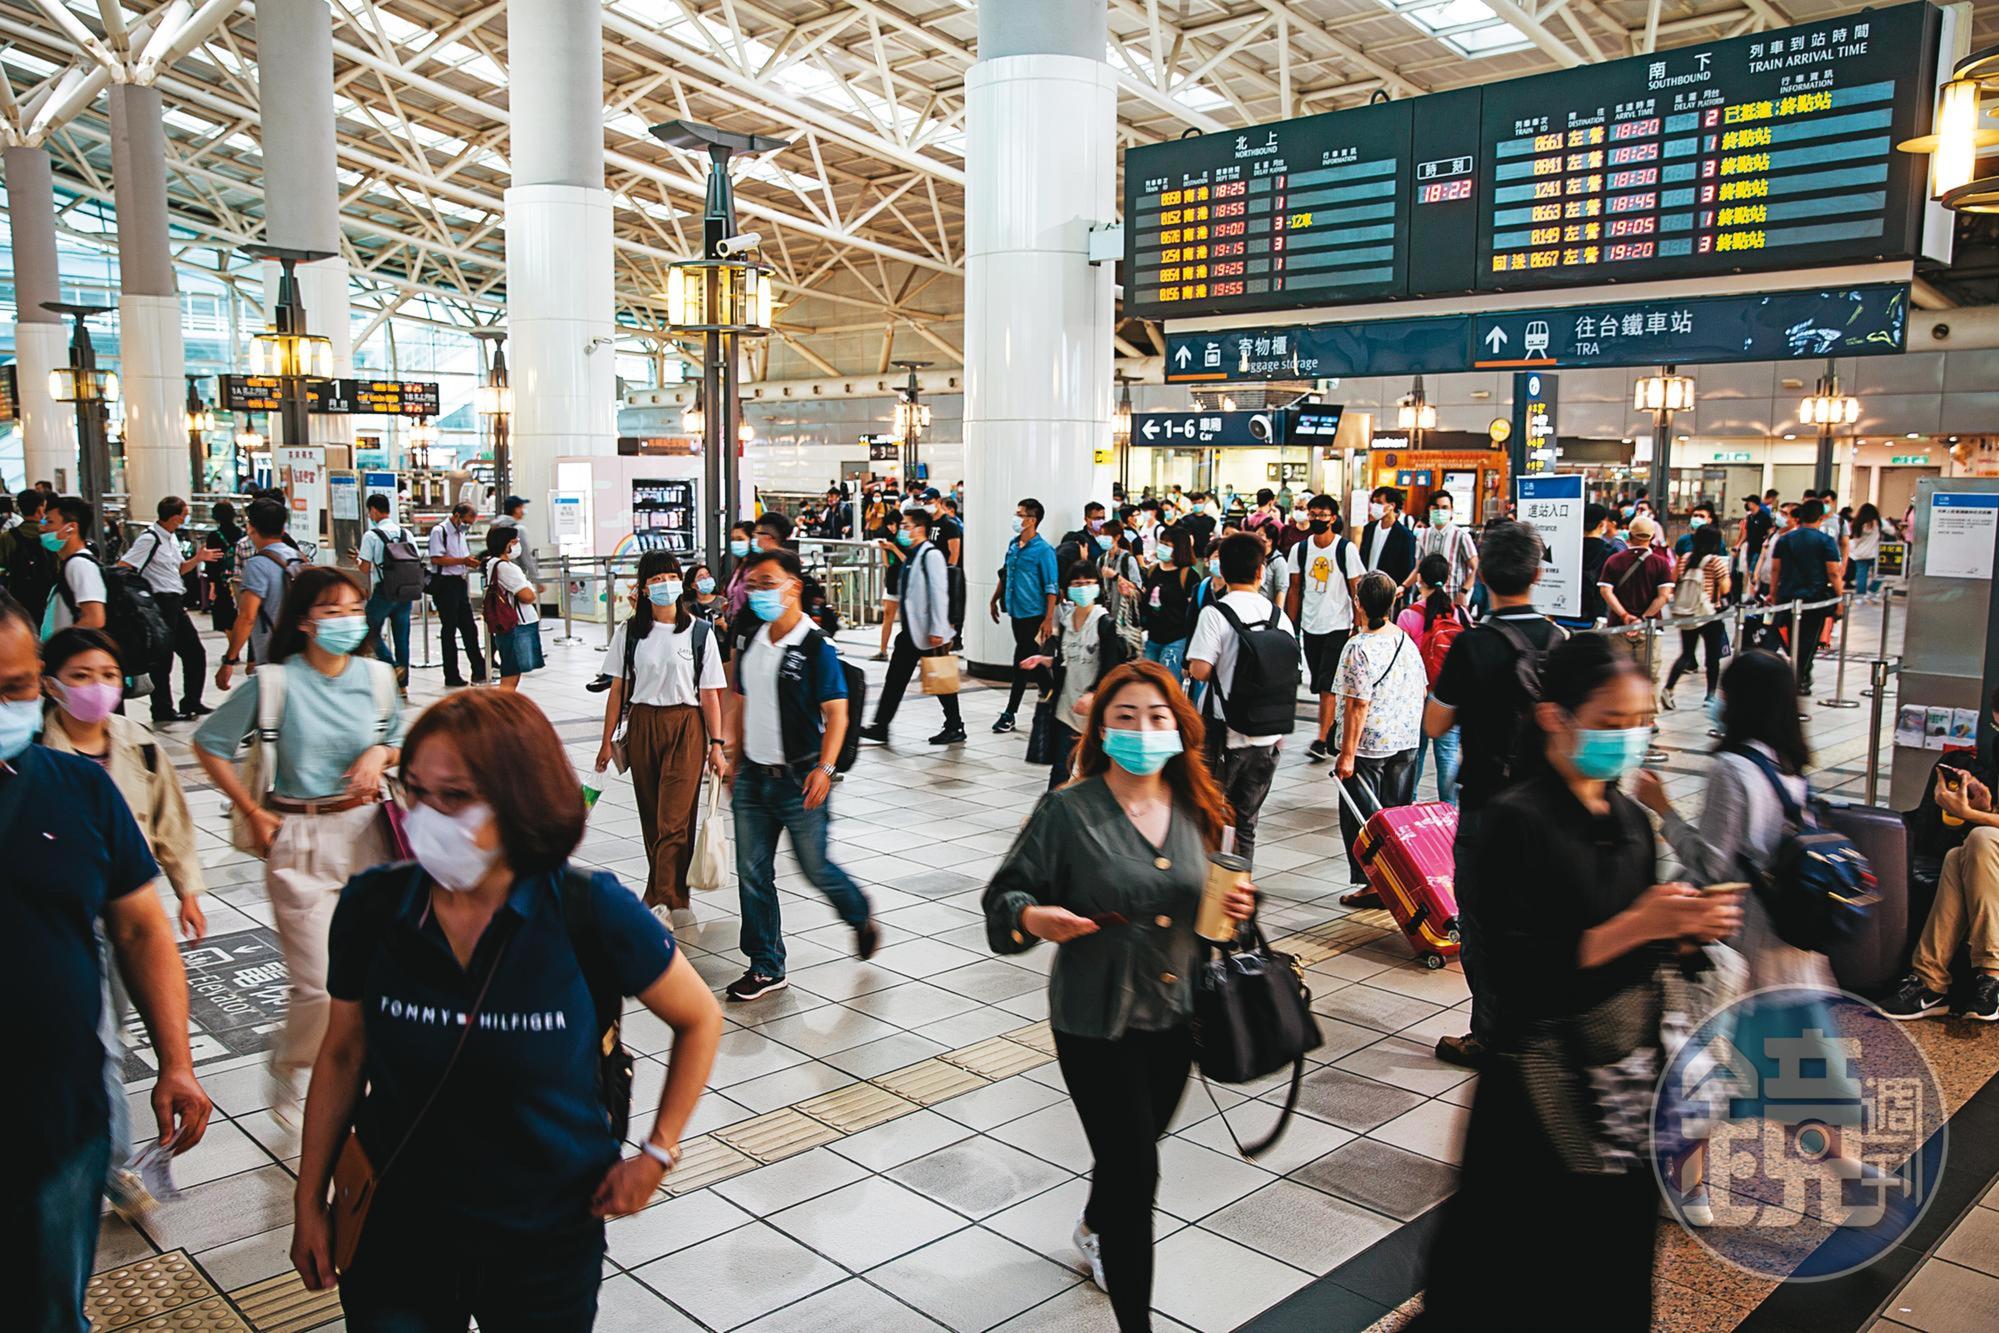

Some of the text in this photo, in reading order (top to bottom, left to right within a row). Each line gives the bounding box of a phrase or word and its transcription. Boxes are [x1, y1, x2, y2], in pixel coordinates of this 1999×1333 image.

[1749, 23, 1869, 59] 列車到站時間
[1649, 52, 1712, 81] 南下
[1749, 42, 1868, 74] TRAIN ARRIVAL TIME
[1648, 71, 1711, 91] SOUTHBOUND
[1780, 78, 1833, 94] INFORMATION
[1515, 127, 1533, 136] TRAIN
[1540, 124, 1548, 132] ID
[1568, 116, 1605, 128] DESTINATION
[1638, 107, 1654, 117] TIME
[1674, 100, 1695, 111] DELAY
[1698, 97, 1724, 108] PLATFORM
[1615, 117, 1660, 139] 18:20
[1704, 108, 1720, 127] 2
[1235, 131, 1277, 151] 北上
[1614, 143, 1659, 163] 18:25
[1710, 135, 1717, 150] 1
[1235, 145, 1278, 159] NORTHBOUND
[1322, 155, 1357, 166] INFORMATION
[1425, 160, 1464, 176] 時刻
[1214, 181, 1245, 198] 18:25
[1278, 176, 1285, 189] 1
[1534, 180, 1562, 199] 1241
[1613, 167, 1658, 187] 18:30
[1703, 160, 1717, 178] 3
[1424, 179, 1472, 203] 18:22
[1214, 202, 1245, 217] 18:55
[1277, 196, 1284, 210] 1
[1532, 203, 1561, 222] 0663
[1612, 192, 1657, 211] 18:45
[1702, 185, 1715, 202] 3
[1214, 221, 1245, 237] 19:00
[1274, 216, 1284, 230] 3
[1611, 217, 1655, 236] 19:05
[1706, 211, 1714, 227] 1
[1213, 241, 1245, 257] 19:15
[1274, 237, 1283, 251] 3
[1610, 241, 1654, 260] 19:20
[1698, 234, 1713, 253] 3
[1213, 261, 1244, 276] 19:25
[1277, 257, 1283, 270] 1
[1213, 281, 1244, 296] 19:55
[1277, 277, 1282, 290] 1
[1575, 309, 1693, 341] 往台鐵車站
[1238, 335, 1288, 357] 寄物櫃
[1576, 341, 1600, 356] TRA
[330, 379, 341, 399] 1
[1163, 419, 1196, 439] 1-6
[1200, 431, 1213, 441] Car
[1282, 464, 1293, 479] 3
[1528, 503, 1569, 518] 進站入口
[187, 974, 259, 1016] Elevator
[380, 995, 567, 1031] TOMMY HILFIGER
